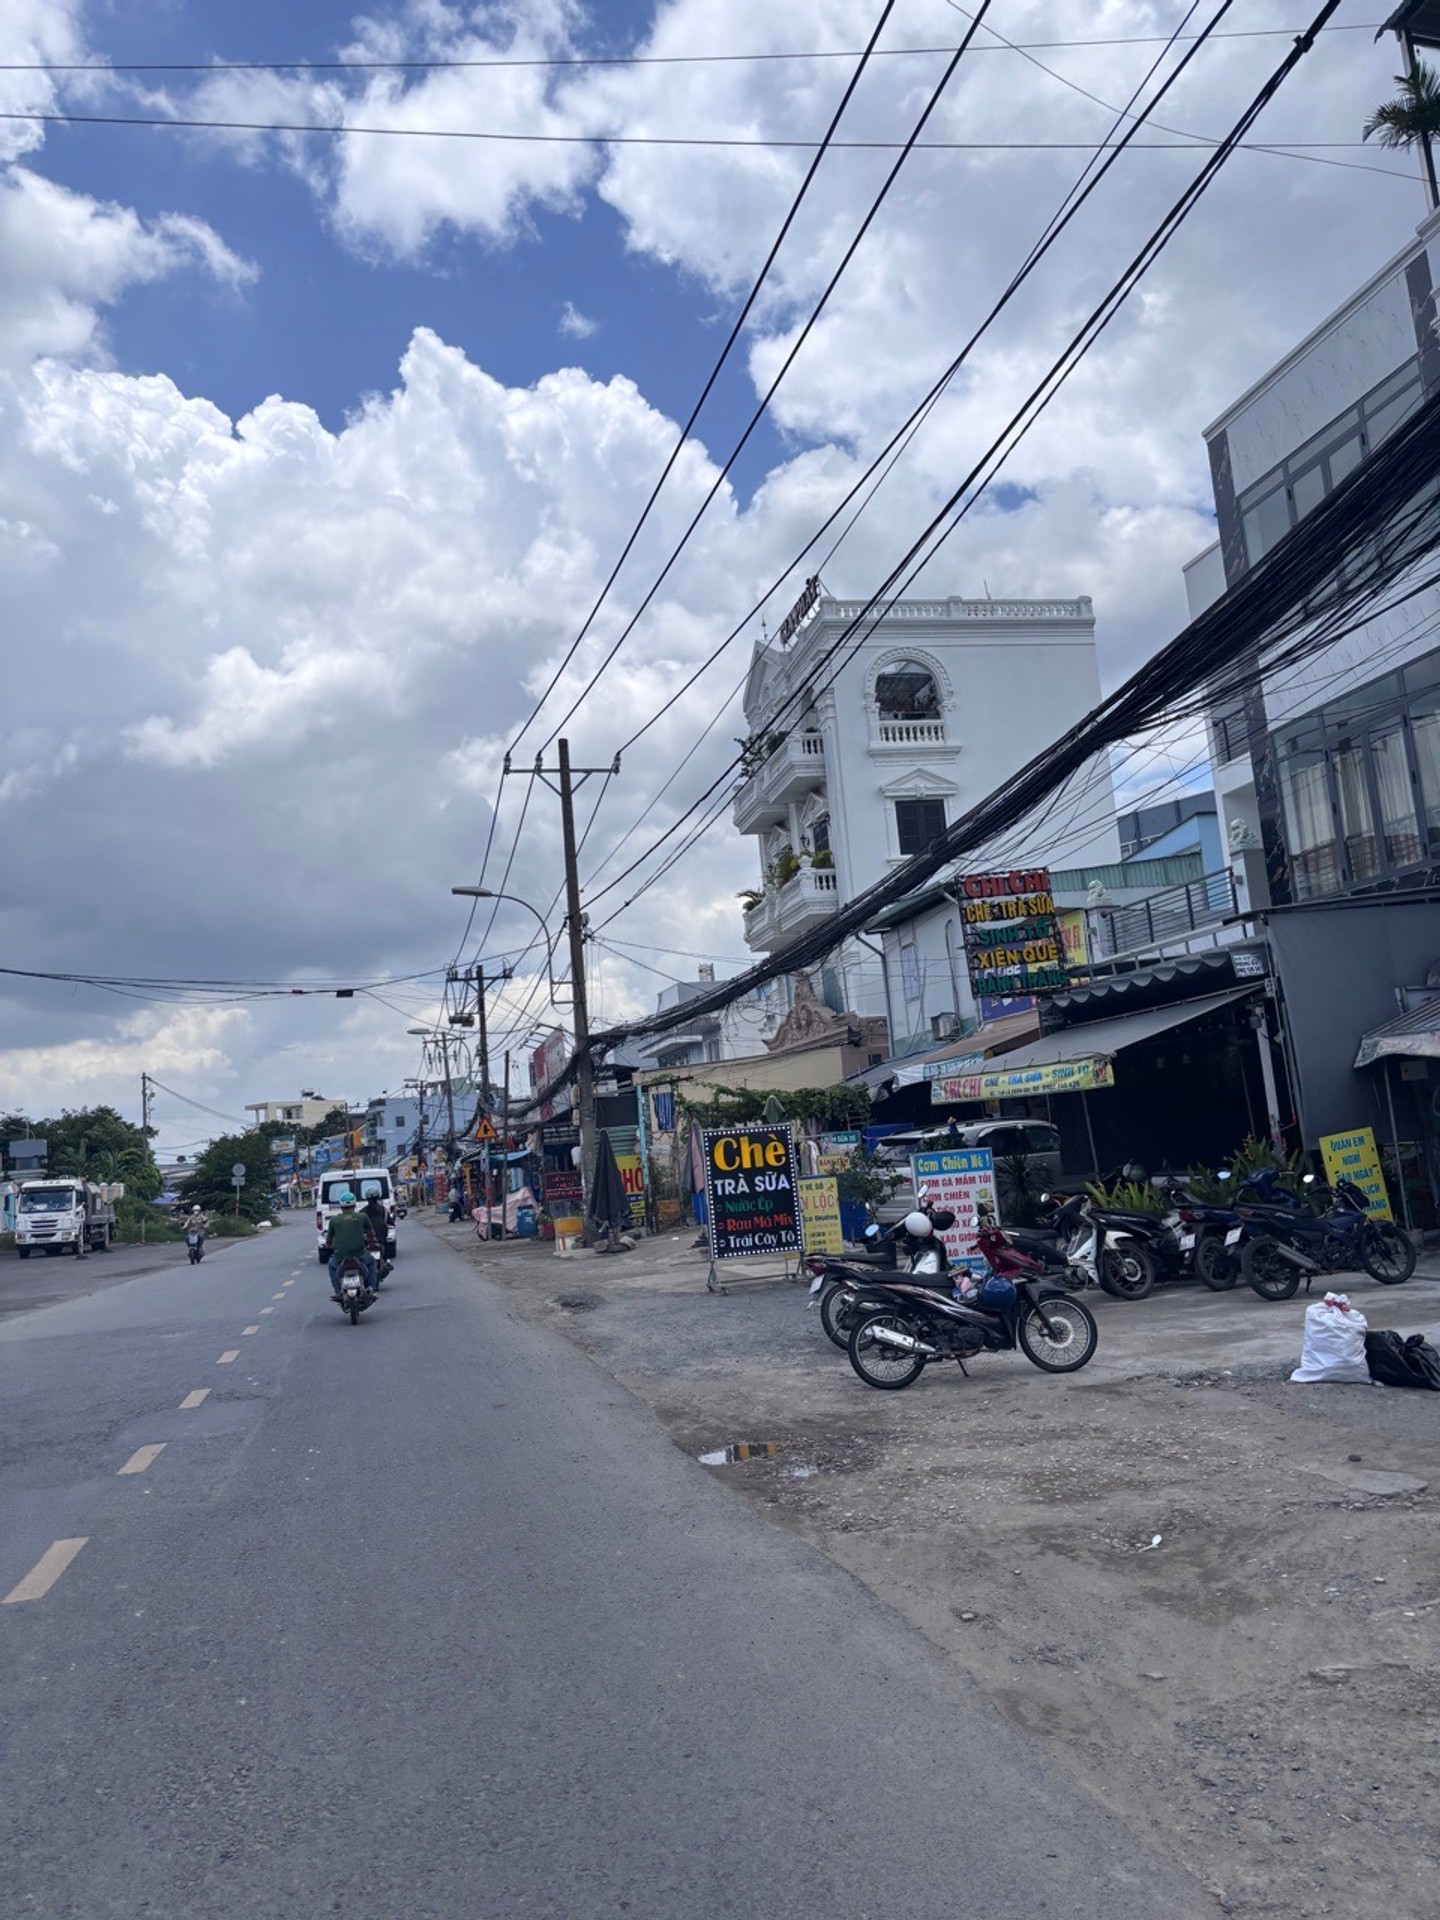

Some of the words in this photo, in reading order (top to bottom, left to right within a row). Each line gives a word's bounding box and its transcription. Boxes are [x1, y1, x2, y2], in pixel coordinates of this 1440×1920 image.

[964, 875, 1006, 899] CHI
[1008, 870, 1049, 894] CHI
[713, 1132, 787, 1172] Chè
[917, 1158, 939, 1173] Cơm
[714, 1173, 750, 1196] TRÀ
[754, 1171, 791, 1193] SỮA
[942, 1176, 954, 1187] GÀ
[724, 1199, 757, 1214] Nước
[813, 1191, 836, 1213] LỘC
[726, 1217, 752, 1232] Rau
[773, 1213, 795, 1227] Mix
[728, 1233, 753, 1249] Trái
[754, 1232, 779, 1247] Cây
[780, 1230, 796, 1243] Tô
